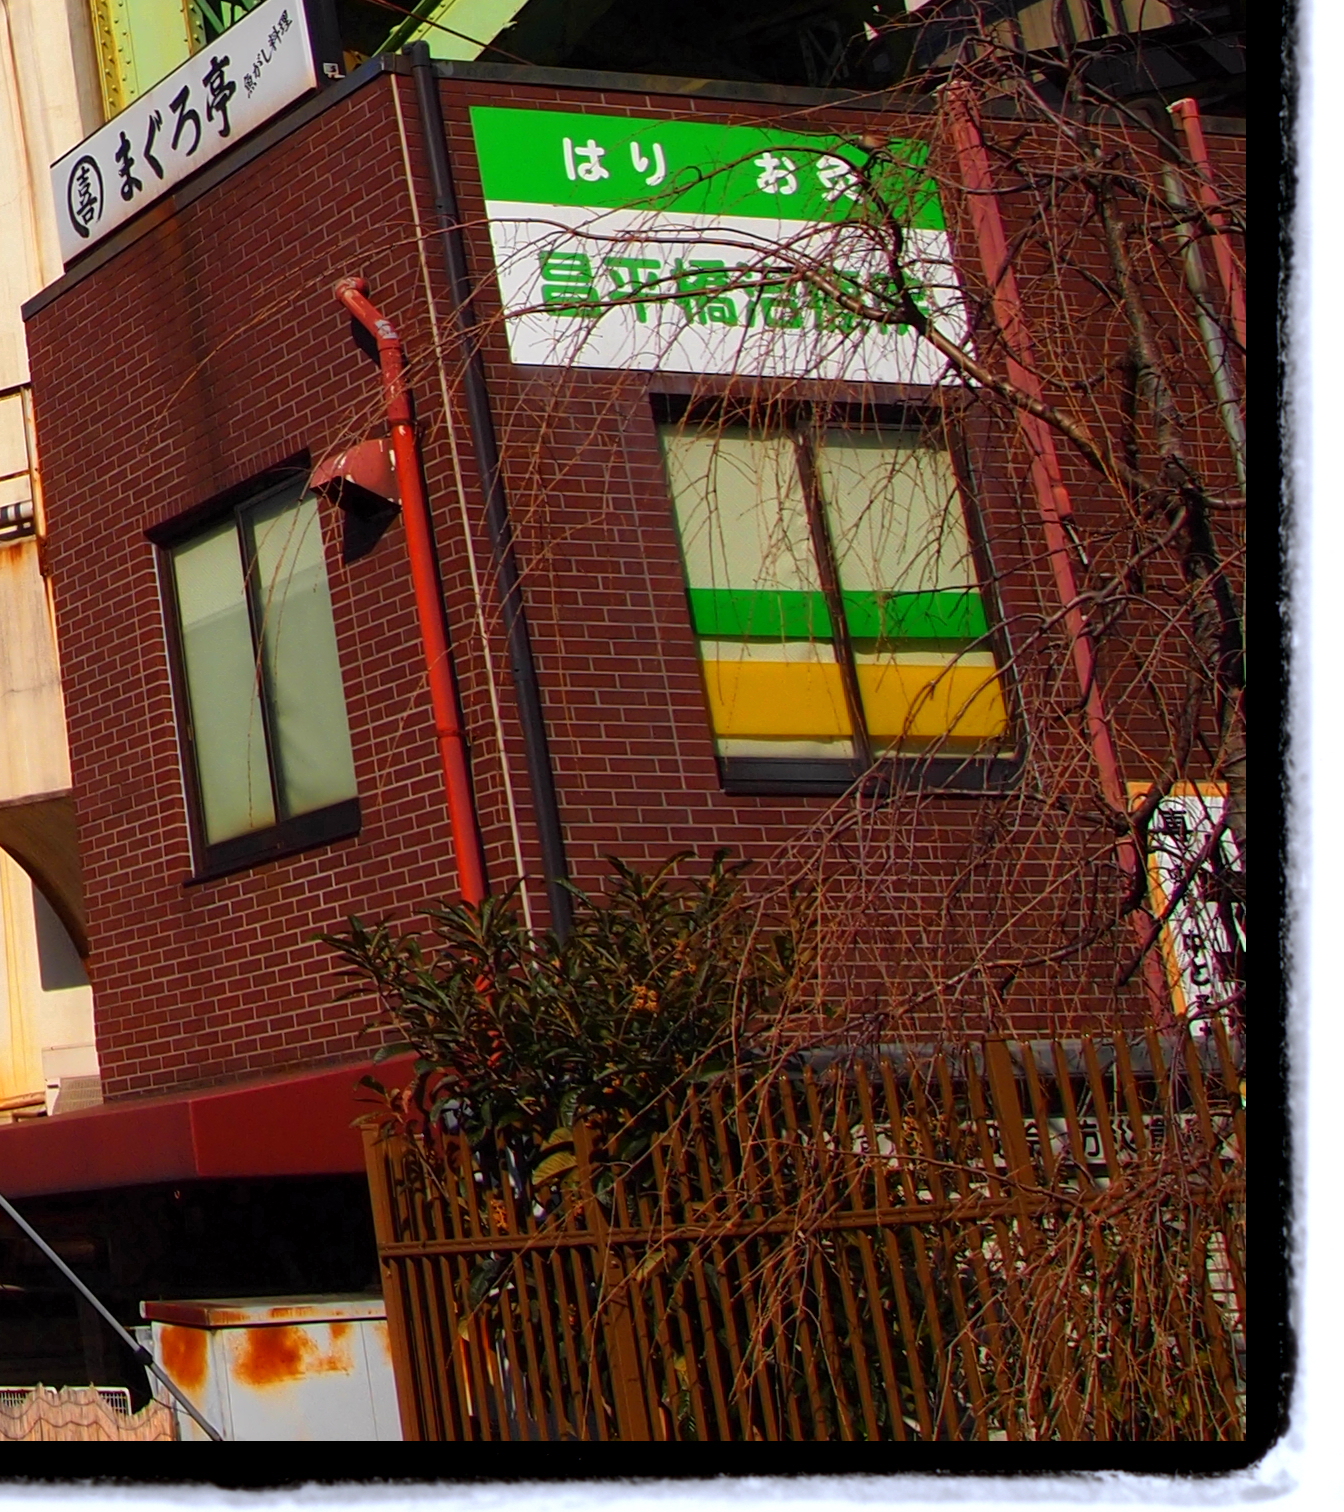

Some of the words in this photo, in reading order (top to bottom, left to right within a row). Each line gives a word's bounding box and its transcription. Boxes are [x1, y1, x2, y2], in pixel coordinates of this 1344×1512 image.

[115, 55, 237, 202] まぐろ亭
[562, 137, 666, 187] はり
